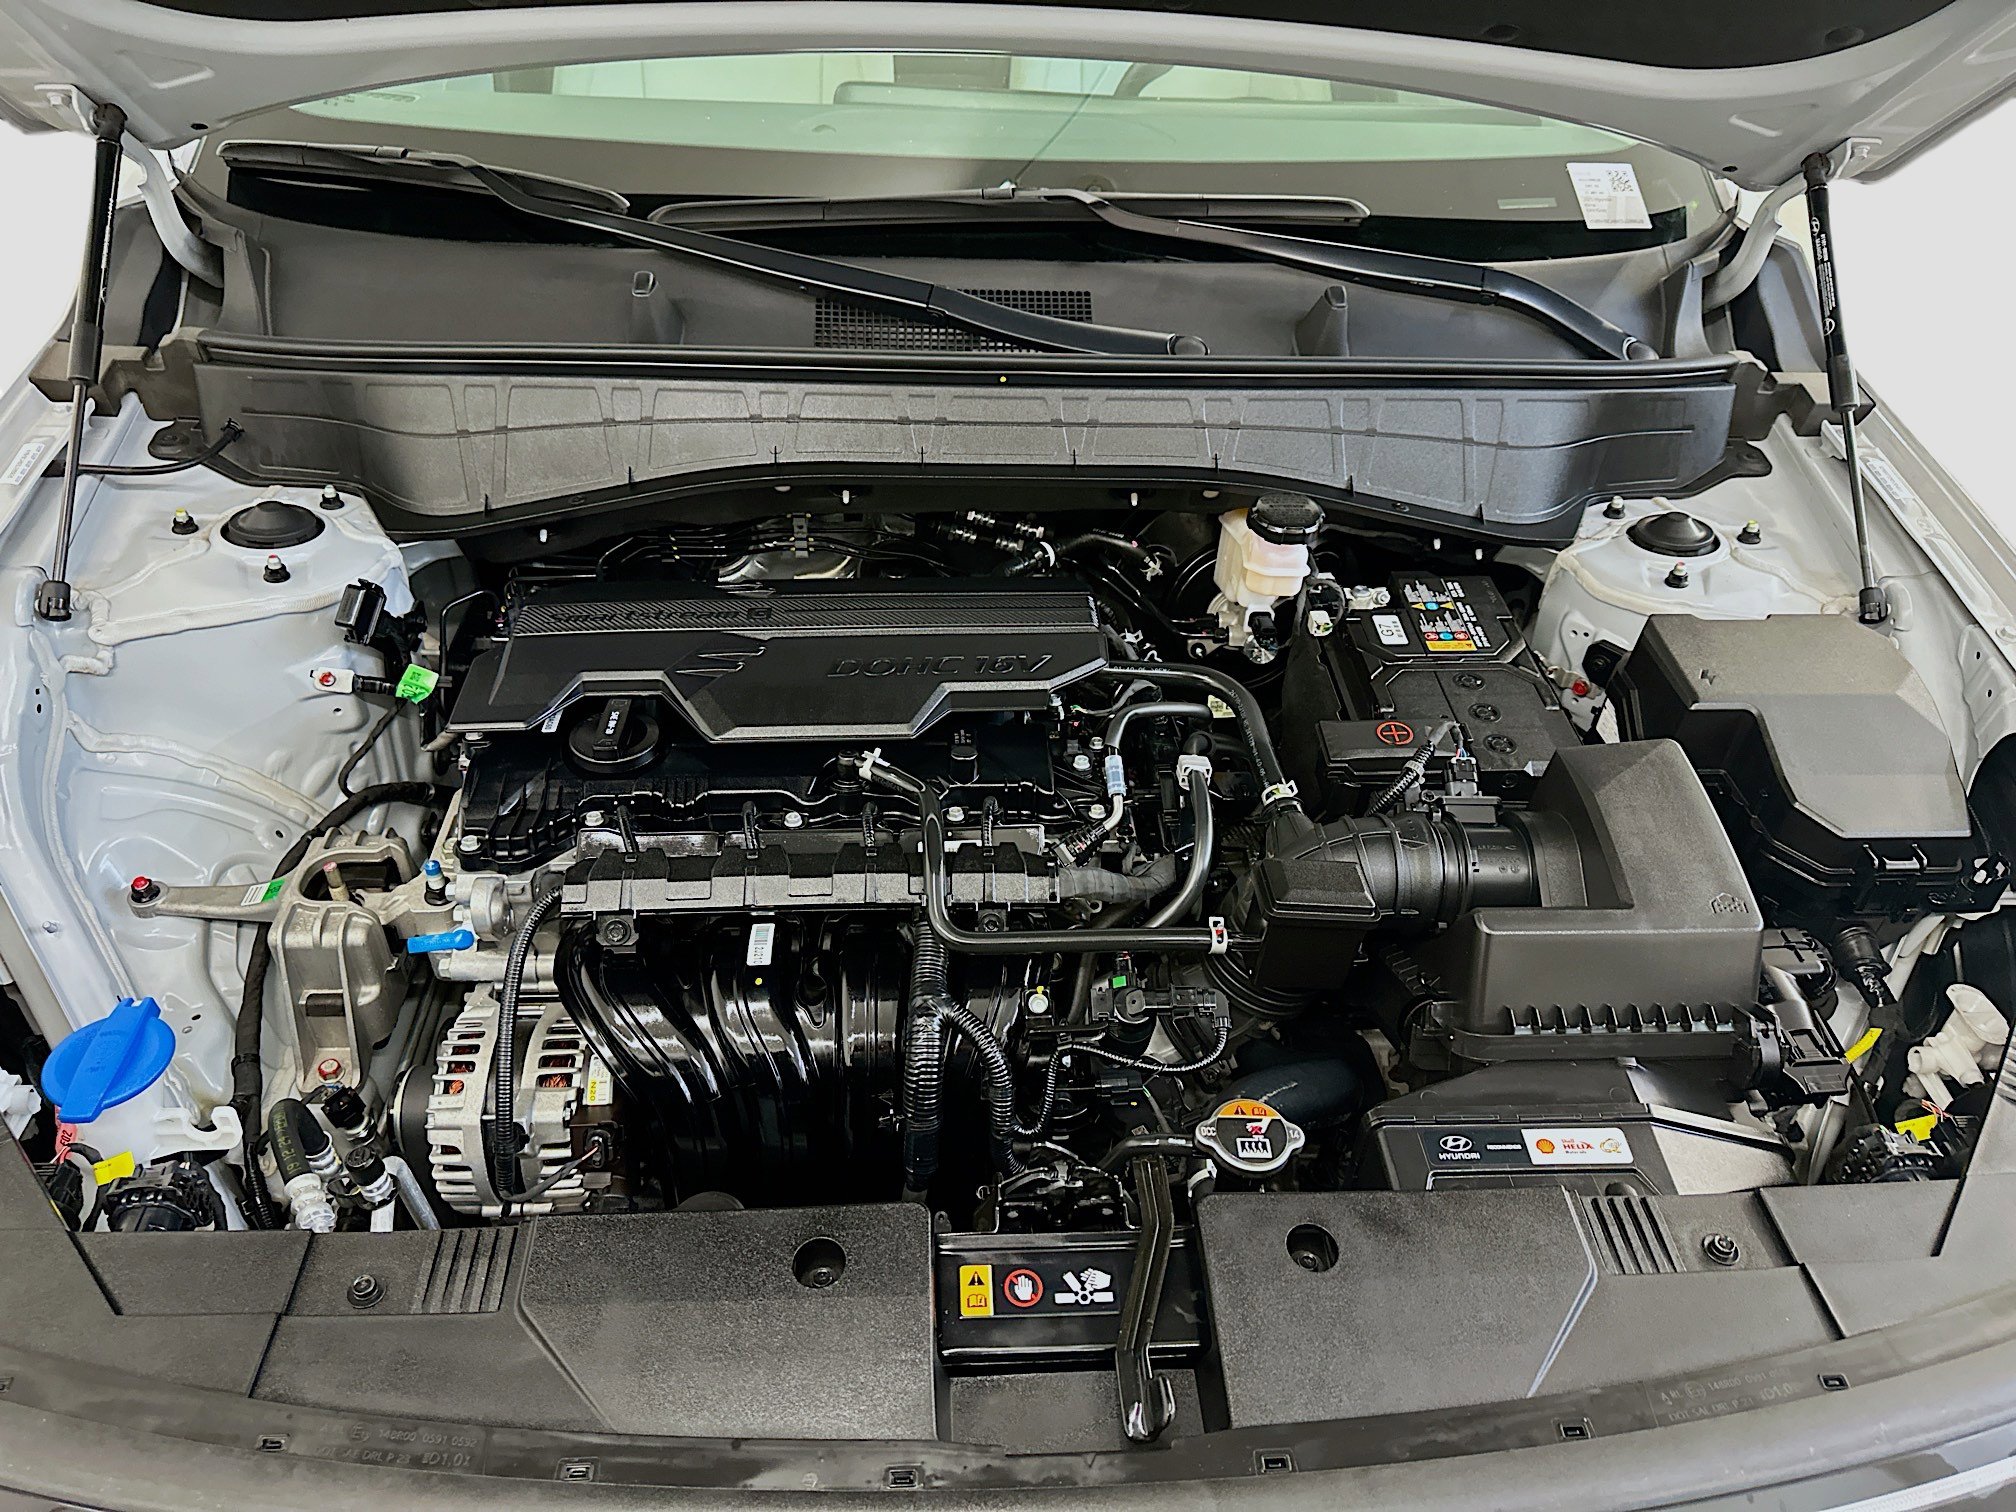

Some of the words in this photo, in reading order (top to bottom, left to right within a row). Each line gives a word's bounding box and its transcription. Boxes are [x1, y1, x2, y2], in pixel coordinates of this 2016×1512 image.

[1381, 623, 1395, 637] G7
[827, 656, 964, 677] DOHC
[974, 654, 1053, 674] 16V
[1562, 1141, 1595, 1150] HELIX
[1439, 1152, 1481, 1160] HYUNDAI
